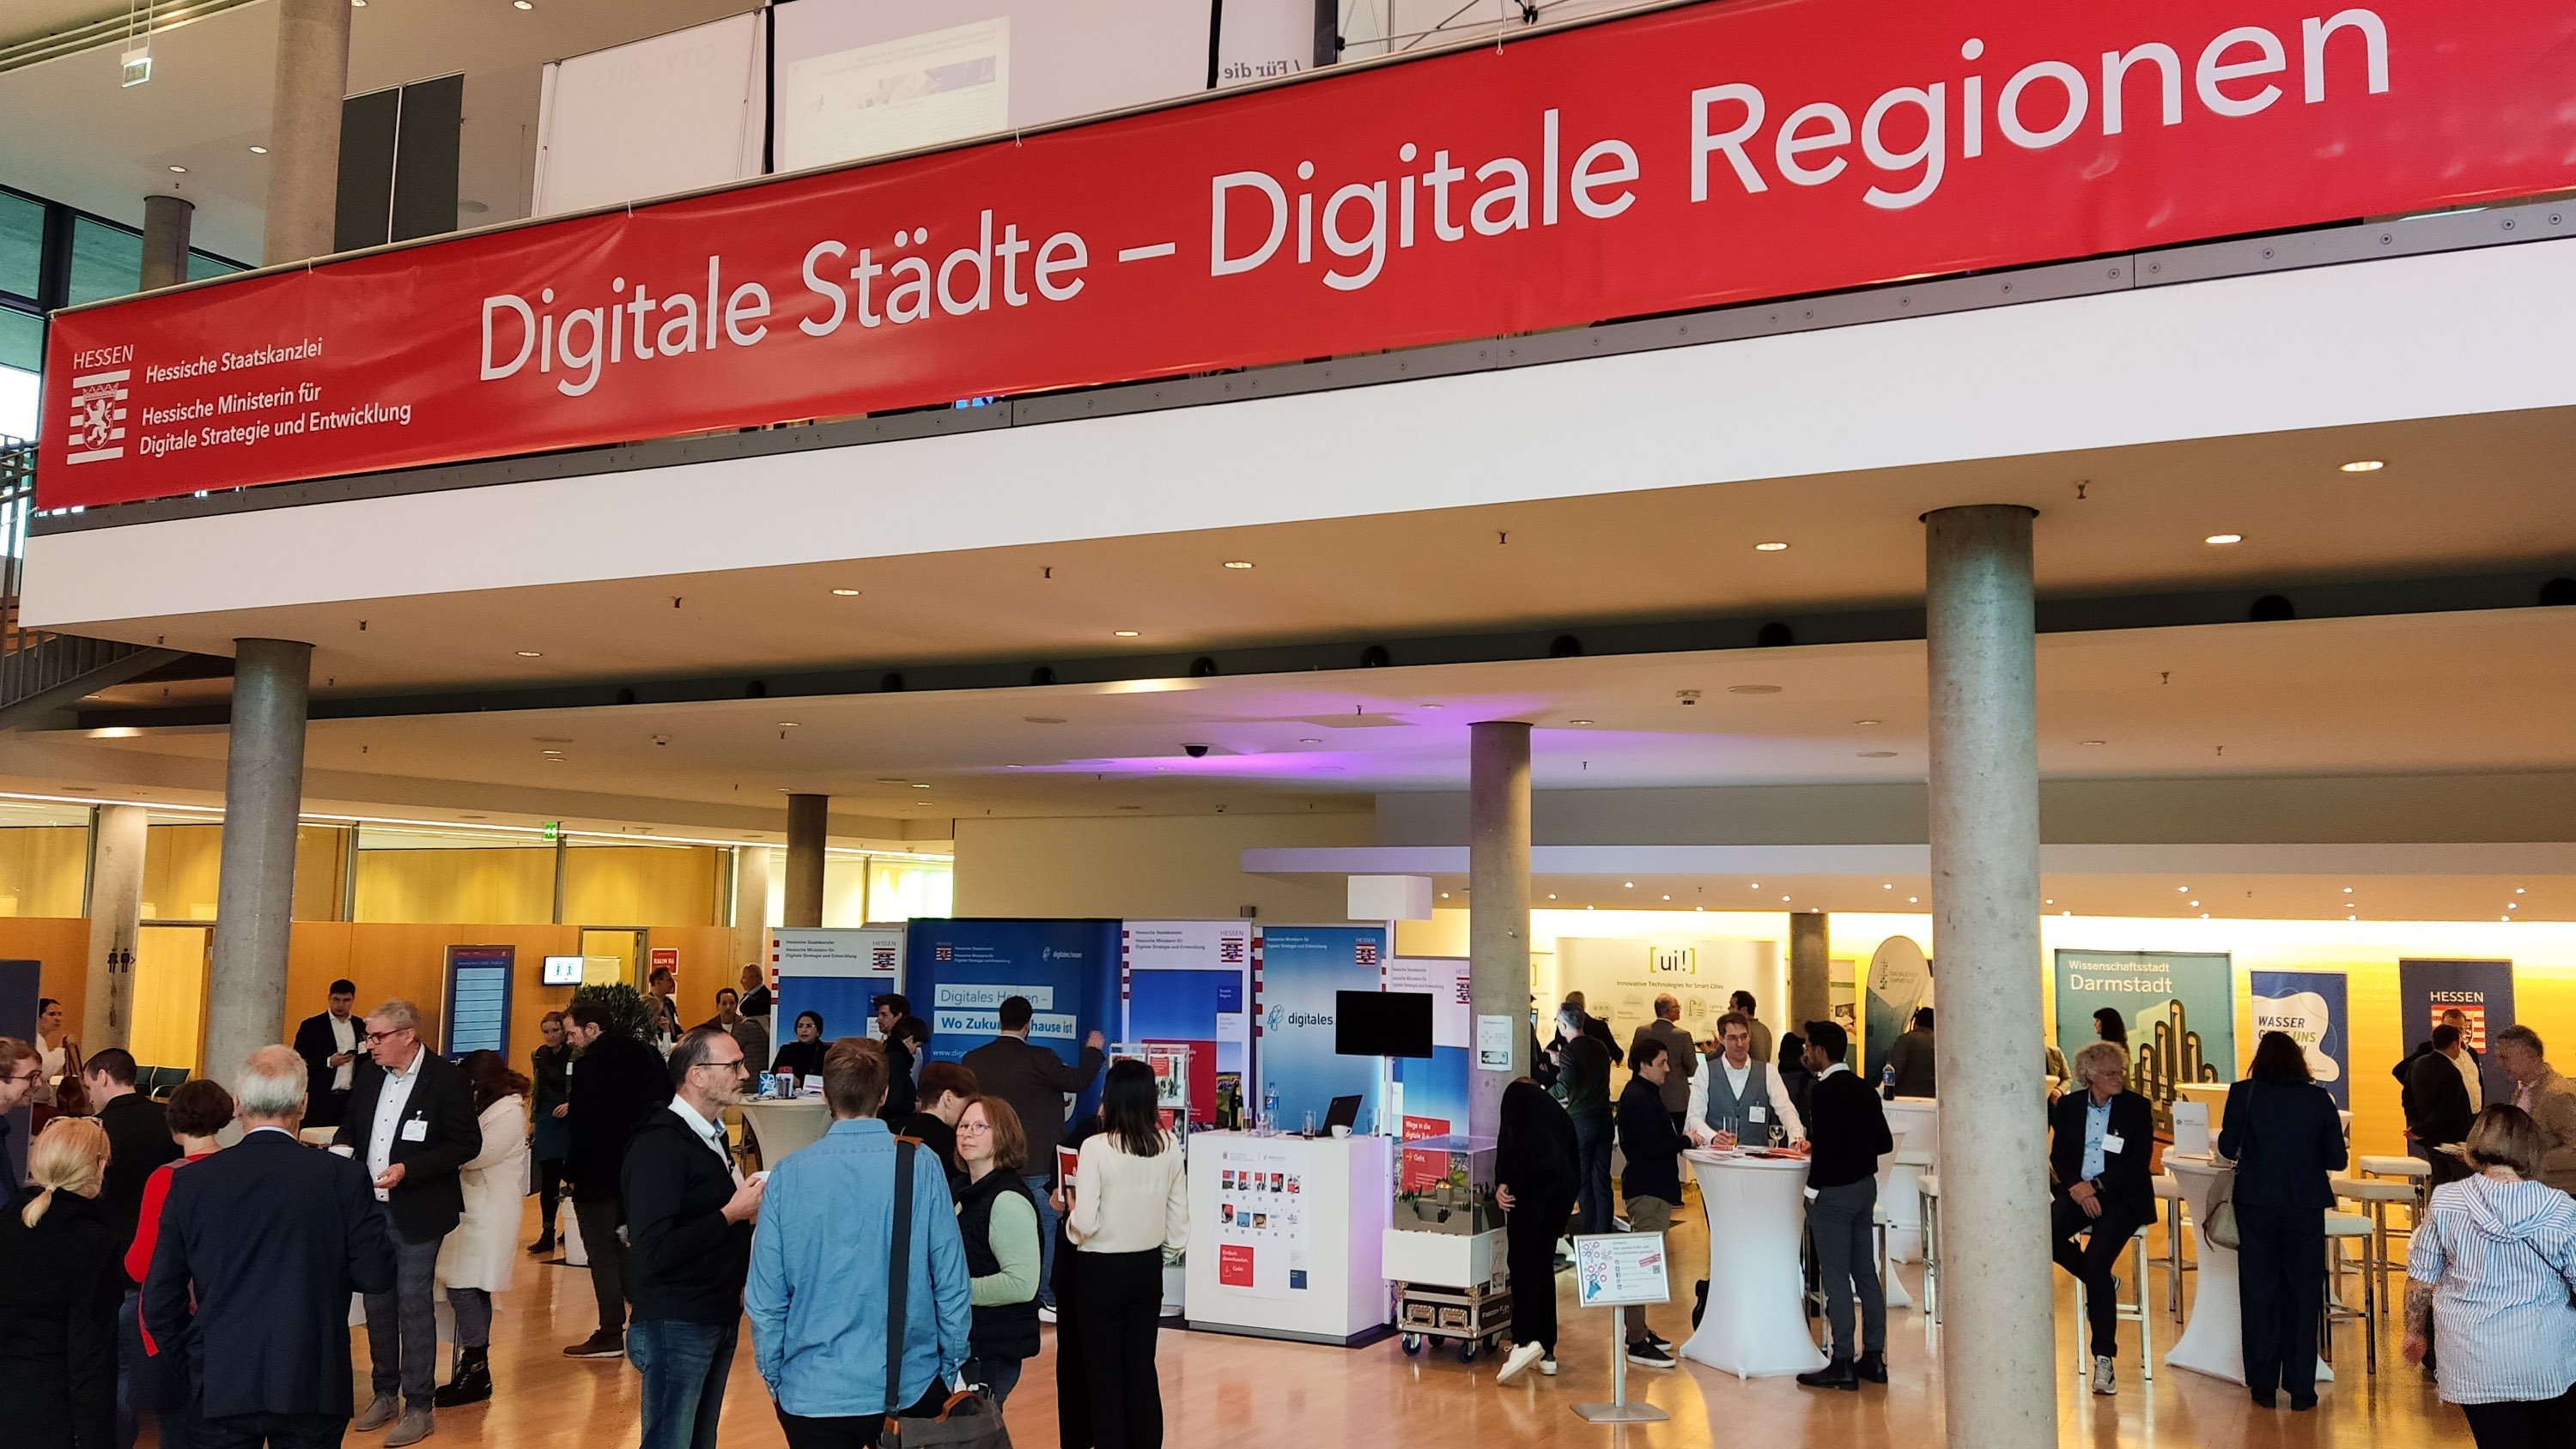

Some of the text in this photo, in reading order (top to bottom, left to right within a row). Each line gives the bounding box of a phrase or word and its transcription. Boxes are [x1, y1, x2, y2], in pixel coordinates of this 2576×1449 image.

[479, 254, 771, 397] Digitale
[799, 209, 1089, 336] Städte
[1211, 108, 1640, 291] Digitale
[1689, 7, 2391, 209] Regionen
[73, 344, 134, 370] HESSEN
[145, 336, 323, 384] Hessische Staatskanzlei
[142, 381, 322, 427] Hessische Ministerin für
[139, 402, 411, 458] Digitale Strategie und Entwicklung
[2069, 960, 2170, 973] Wissenschaftsstadt
[2070, 974, 2172, 993] Darmstadt
[941, 990, 993, 1005] Digitales
[2430, 991, 2484, 1003] HESSEN
[941, 1017, 1072, 1034] Wo Zuku hause ist
[1288, 1012, 1334, 1028] digitales
[2258, 1016, 2306, 1028] WASSER
[2293, 1031, 2316, 1043] UNS
